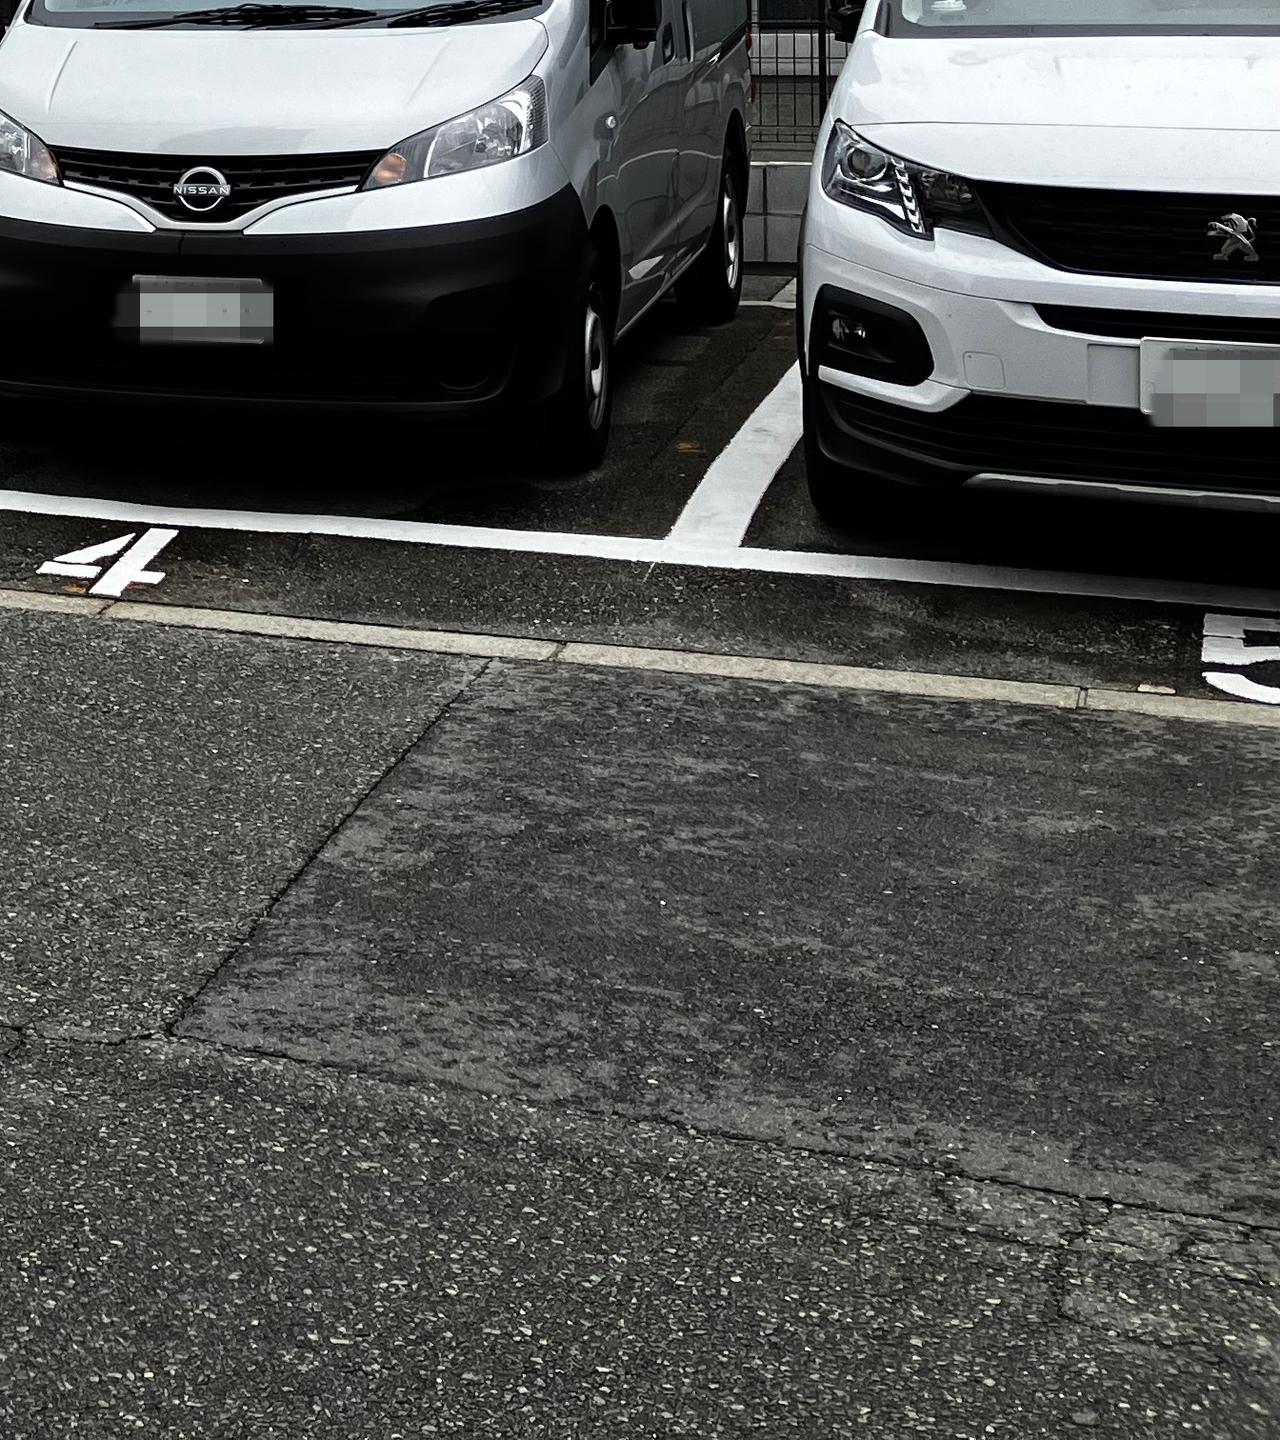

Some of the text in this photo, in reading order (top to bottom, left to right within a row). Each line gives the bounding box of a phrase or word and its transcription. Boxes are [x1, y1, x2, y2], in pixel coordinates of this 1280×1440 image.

[173, 184, 231, 196] NISSAN
[35, 528, 179, 597] 4
[1201, 613, 1280, 704] 5
